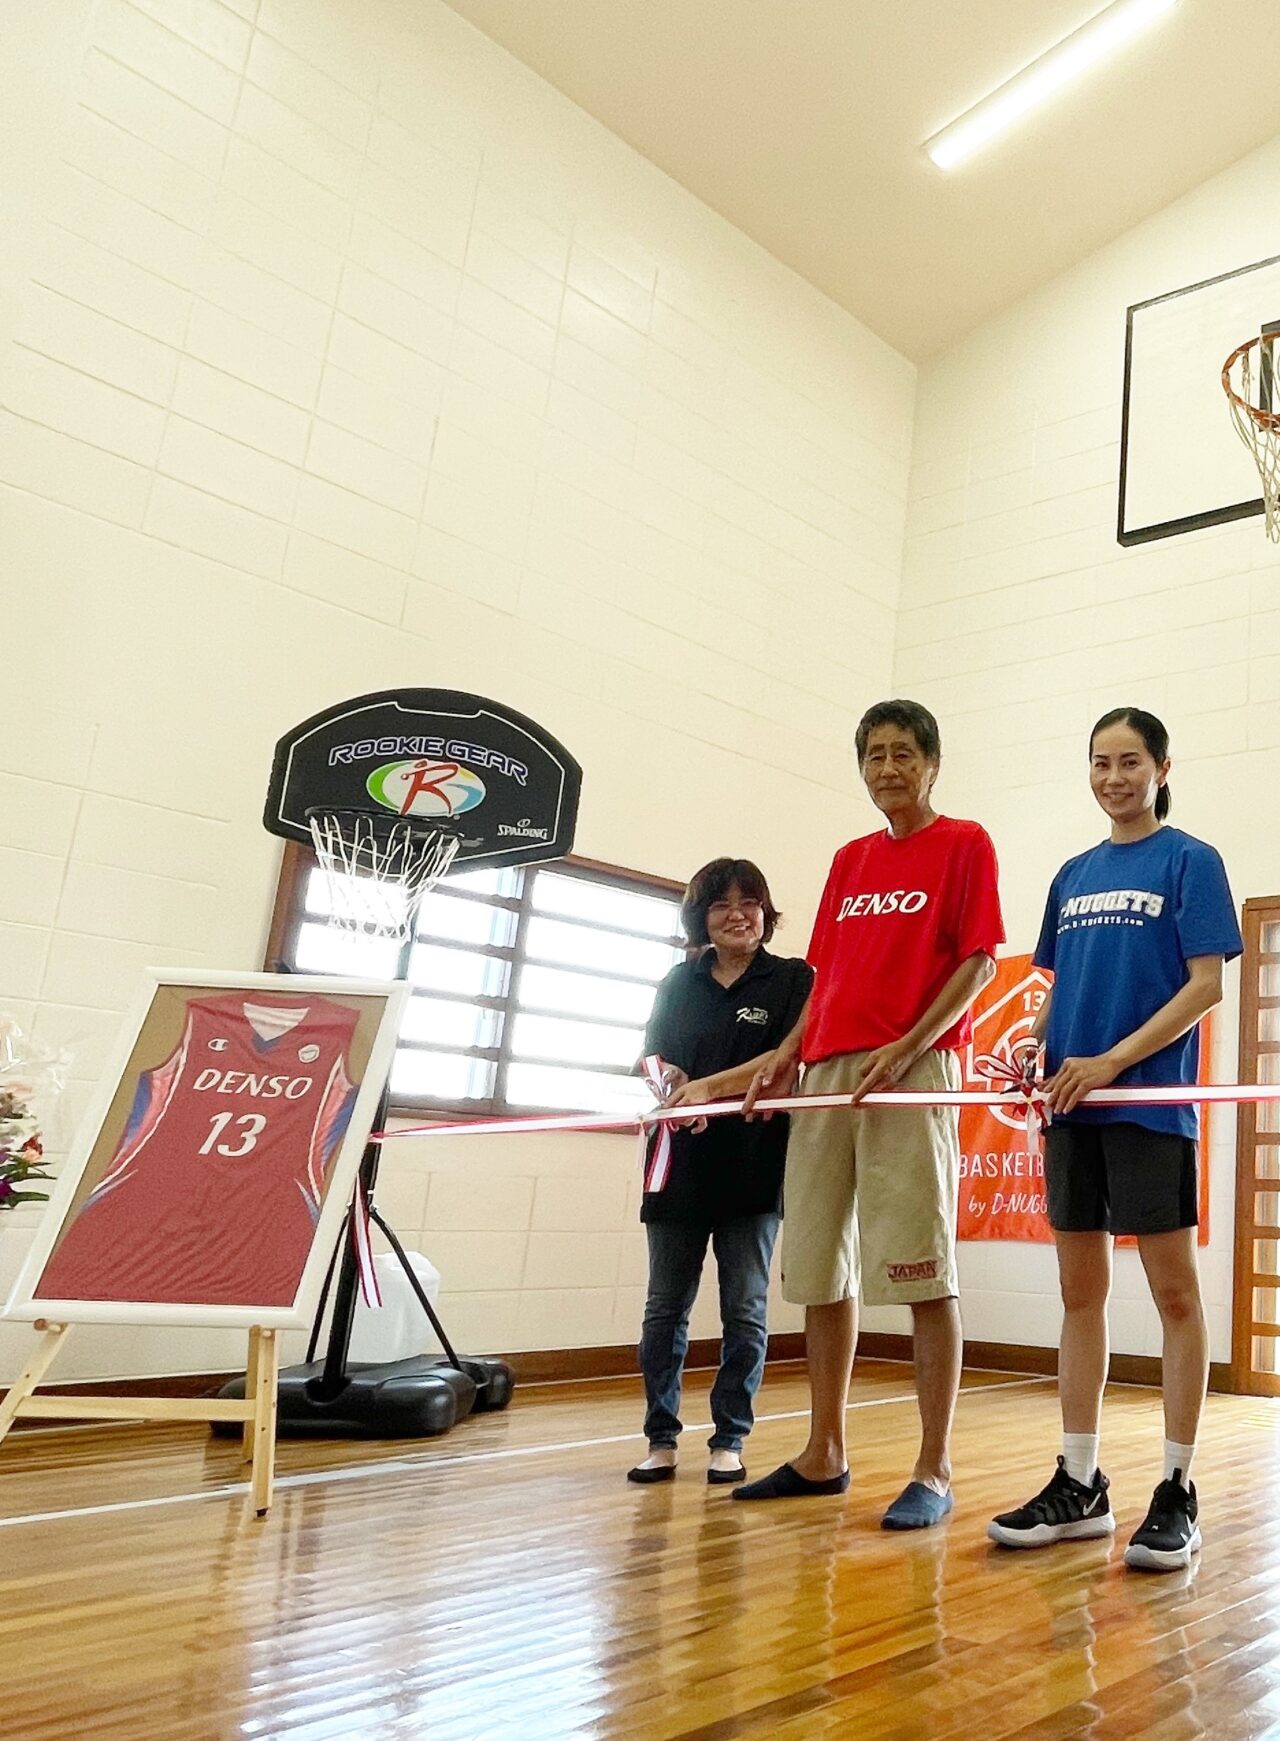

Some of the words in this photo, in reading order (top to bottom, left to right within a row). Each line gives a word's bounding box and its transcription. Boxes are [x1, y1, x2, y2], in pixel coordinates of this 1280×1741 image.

[328, 736, 445, 766] ROOKIE
[446, 739, 528, 787] GEAR
[497, 824, 549, 840] SPALDING
[836, 890, 928, 922] DENSO
[1060, 889, 1165, 919] -NUGGETS
[1022, 990, 1046, 1011] 13
[193, 1068, 313, 1099] DENSO
[198, 1111, 267, 1157] 13
[959, 1151, 1045, 1179] BASKETB
[968, 1198, 986, 1217] by
[991, 1192, 1048, 1216] D-NUGG
[887, 1260, 938, 1282] JAPAN
